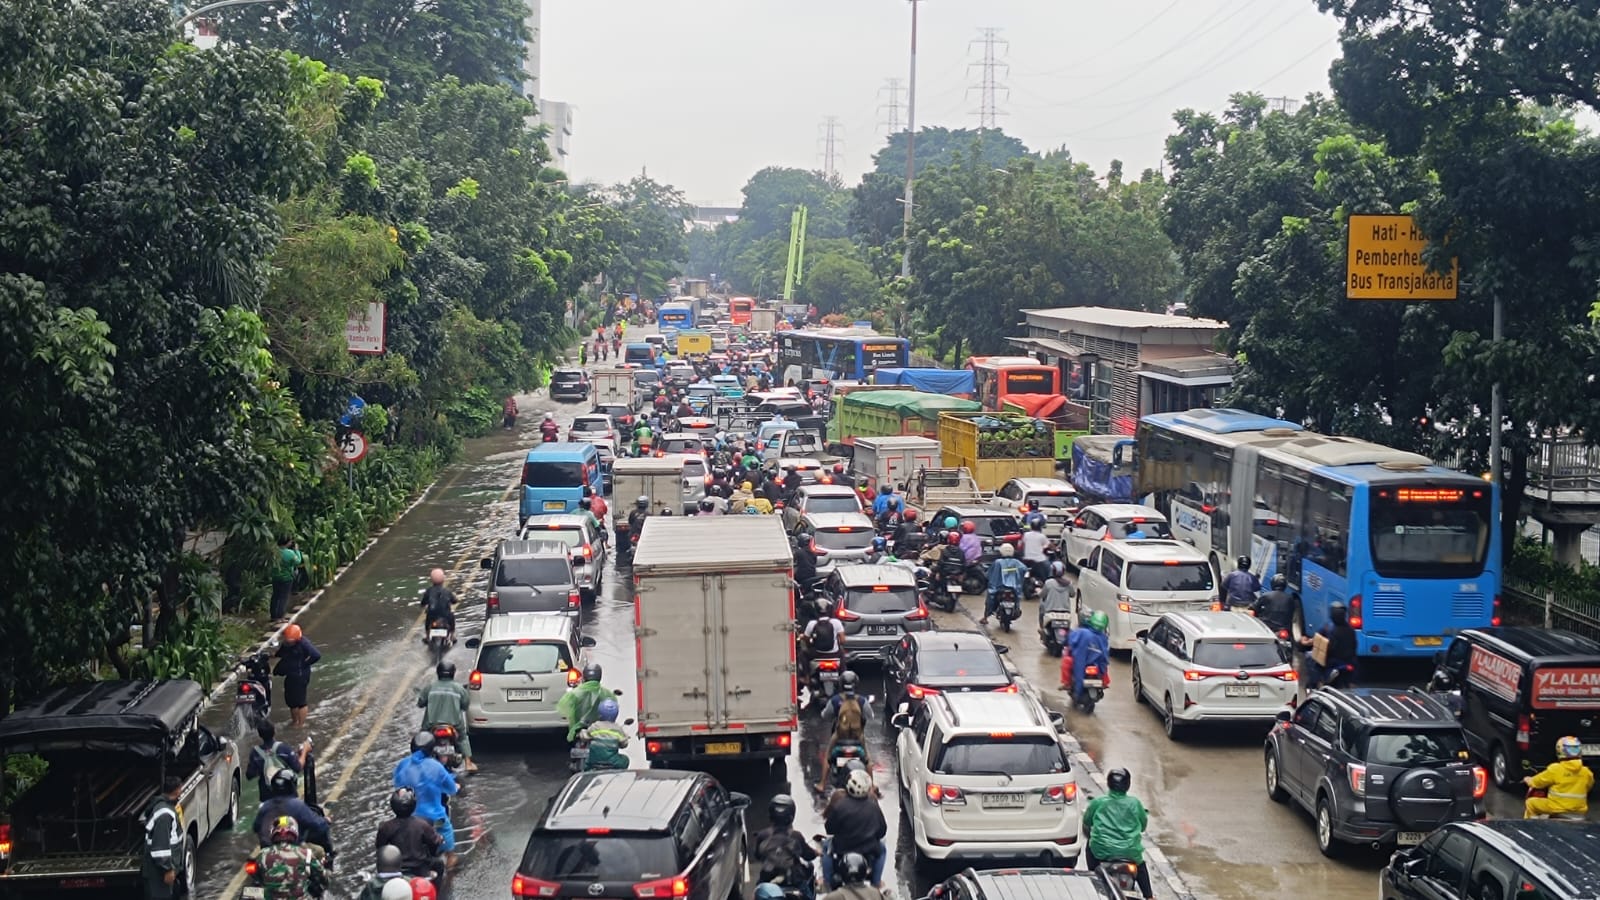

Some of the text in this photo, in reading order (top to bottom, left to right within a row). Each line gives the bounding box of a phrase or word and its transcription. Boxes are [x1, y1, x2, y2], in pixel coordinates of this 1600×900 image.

[1372, 224, 1397, 241] Hati
[1410, 225, 1430, 241] Ha
[1356, 249, 1425, 266] Pemberhe
[1351, 272, 1453, 294] Bus Transjakarta
[1477, 652, 1520, 684] LALAMOVE
